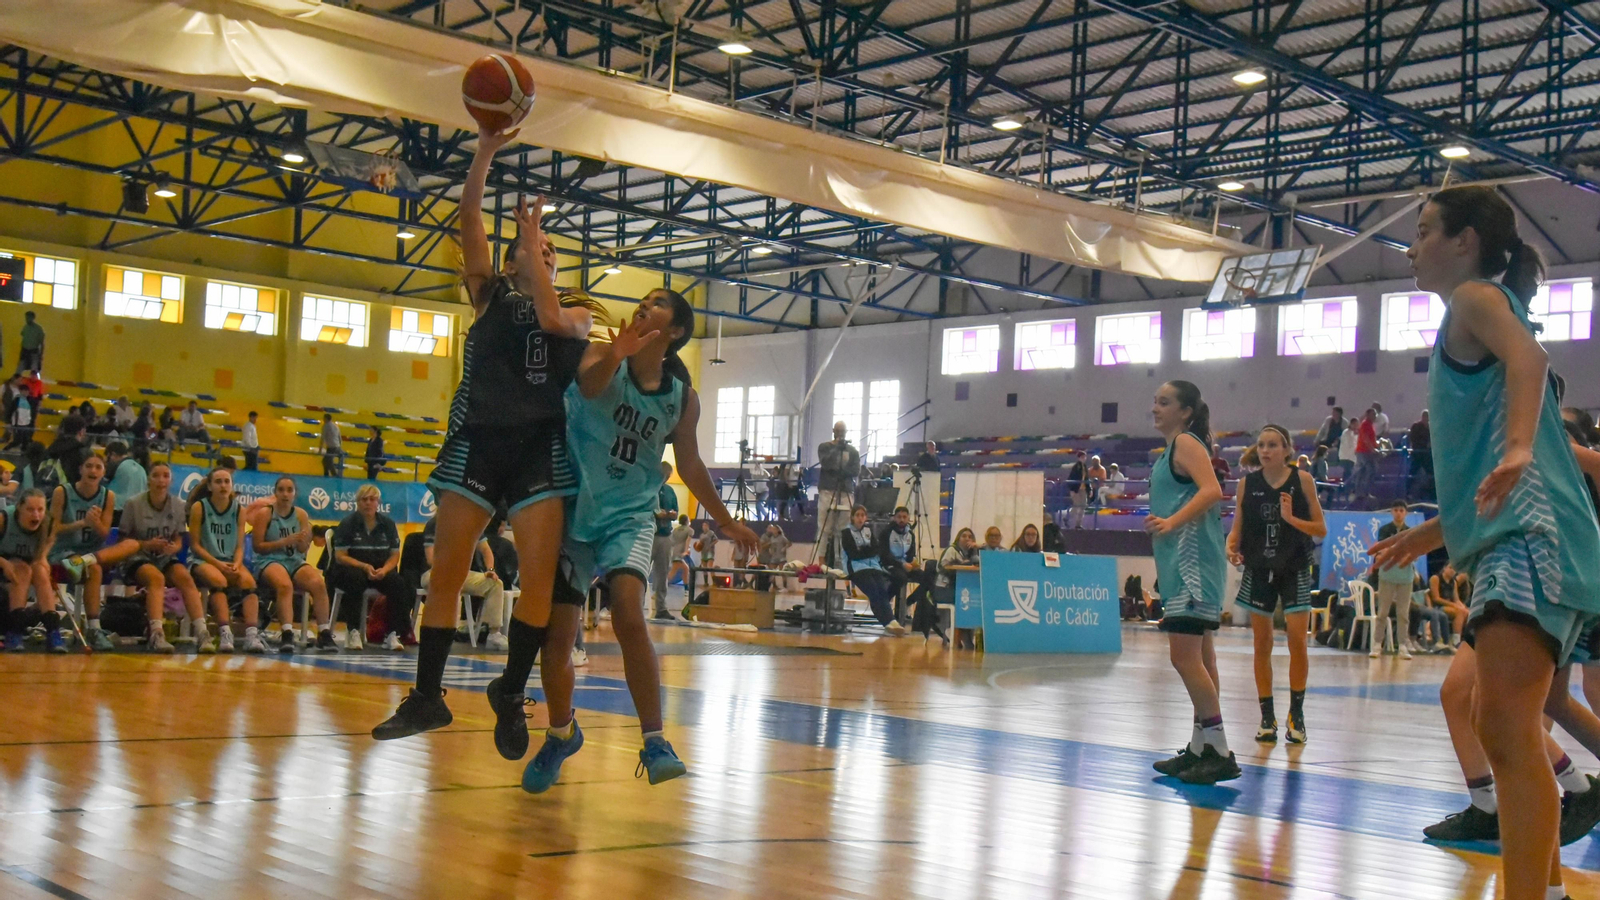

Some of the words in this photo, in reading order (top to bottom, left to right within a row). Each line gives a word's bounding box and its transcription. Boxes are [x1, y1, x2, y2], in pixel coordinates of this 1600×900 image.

[526, 330, 547, 368] 8
[613, 403, 659, 441] MLG
[609, 435, 638, 466] 10
[467, 477, 486, 492] vive
[211, 523, 231, 535] MLG
[216, 539, 226, 554] 11
[1043, 581, 1110, 601] Diputación
[1045, 608, 1061, 624] de
[1065, 607, 1099, 626] Cádiz
